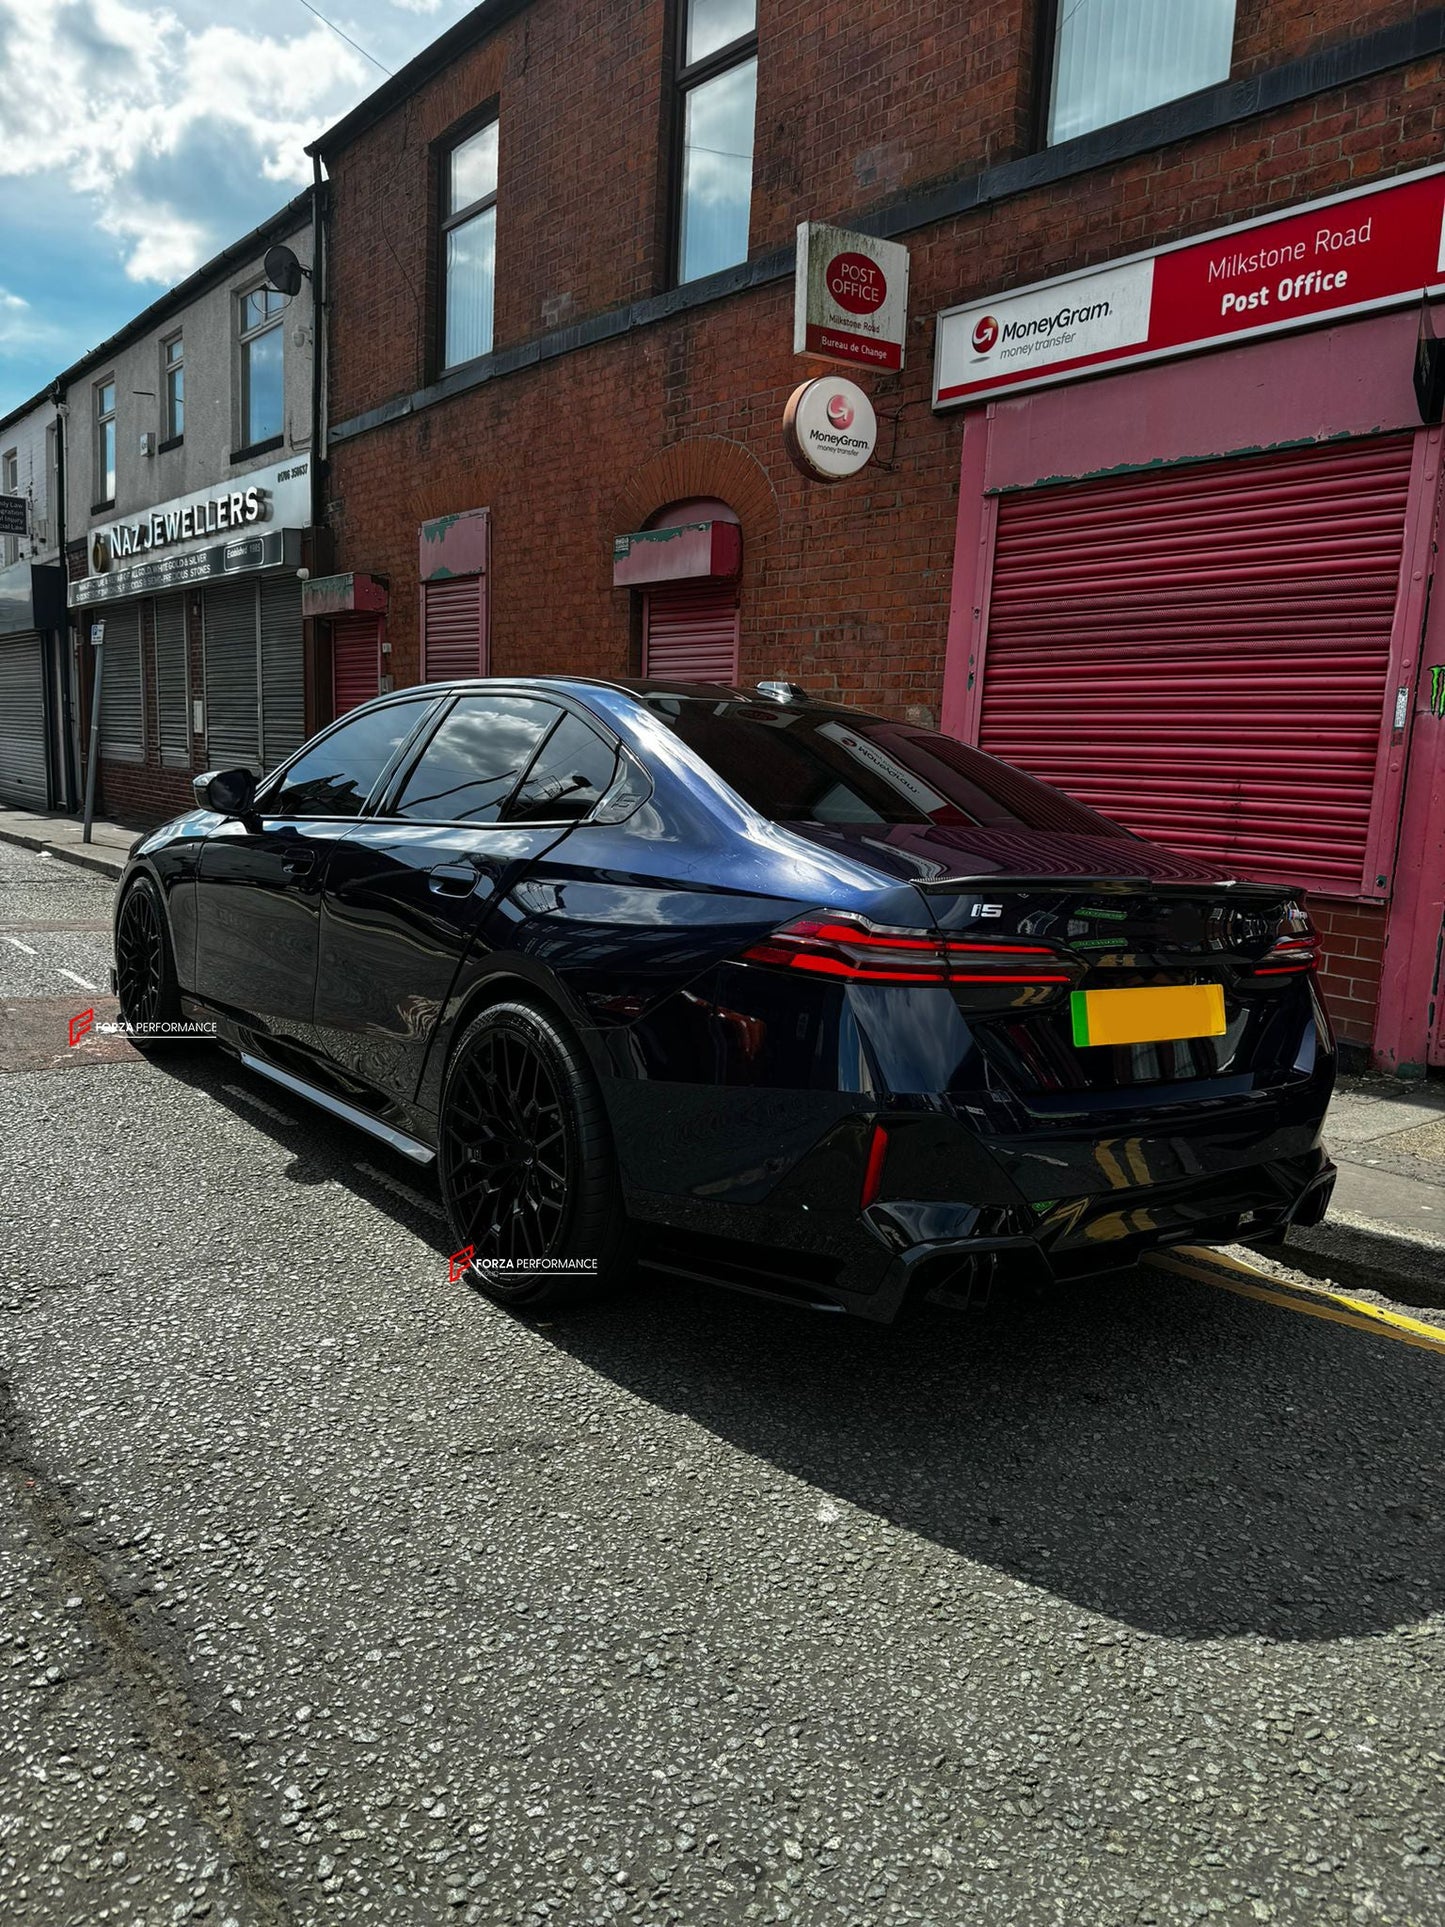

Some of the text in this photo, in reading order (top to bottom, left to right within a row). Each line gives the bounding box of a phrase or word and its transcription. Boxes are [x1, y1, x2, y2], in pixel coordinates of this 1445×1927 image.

[1208, 217, 1372, 283] Milkstone Road
[841, 263, 876, 284] POST
[832, 278, 879, 302] OFFICE
[1221, 269, 1348, 316] Post Office
[829, 314, 880, 333] Milkstone Road
[1001, 301, 1112, 342] MoneyGram
[821, 335, 887, 359] Bureau de Change
[1000, 332, 1076, 360] money transfer
[809, 429, 869, 449] MoneyGram
[817, 443, 859, 456] money transfer
[110, 485, 259, 559] NAZ JEWELLERS
[189, 553, 207, 566] SILVER
[190, 564, 211, 577] STONES
